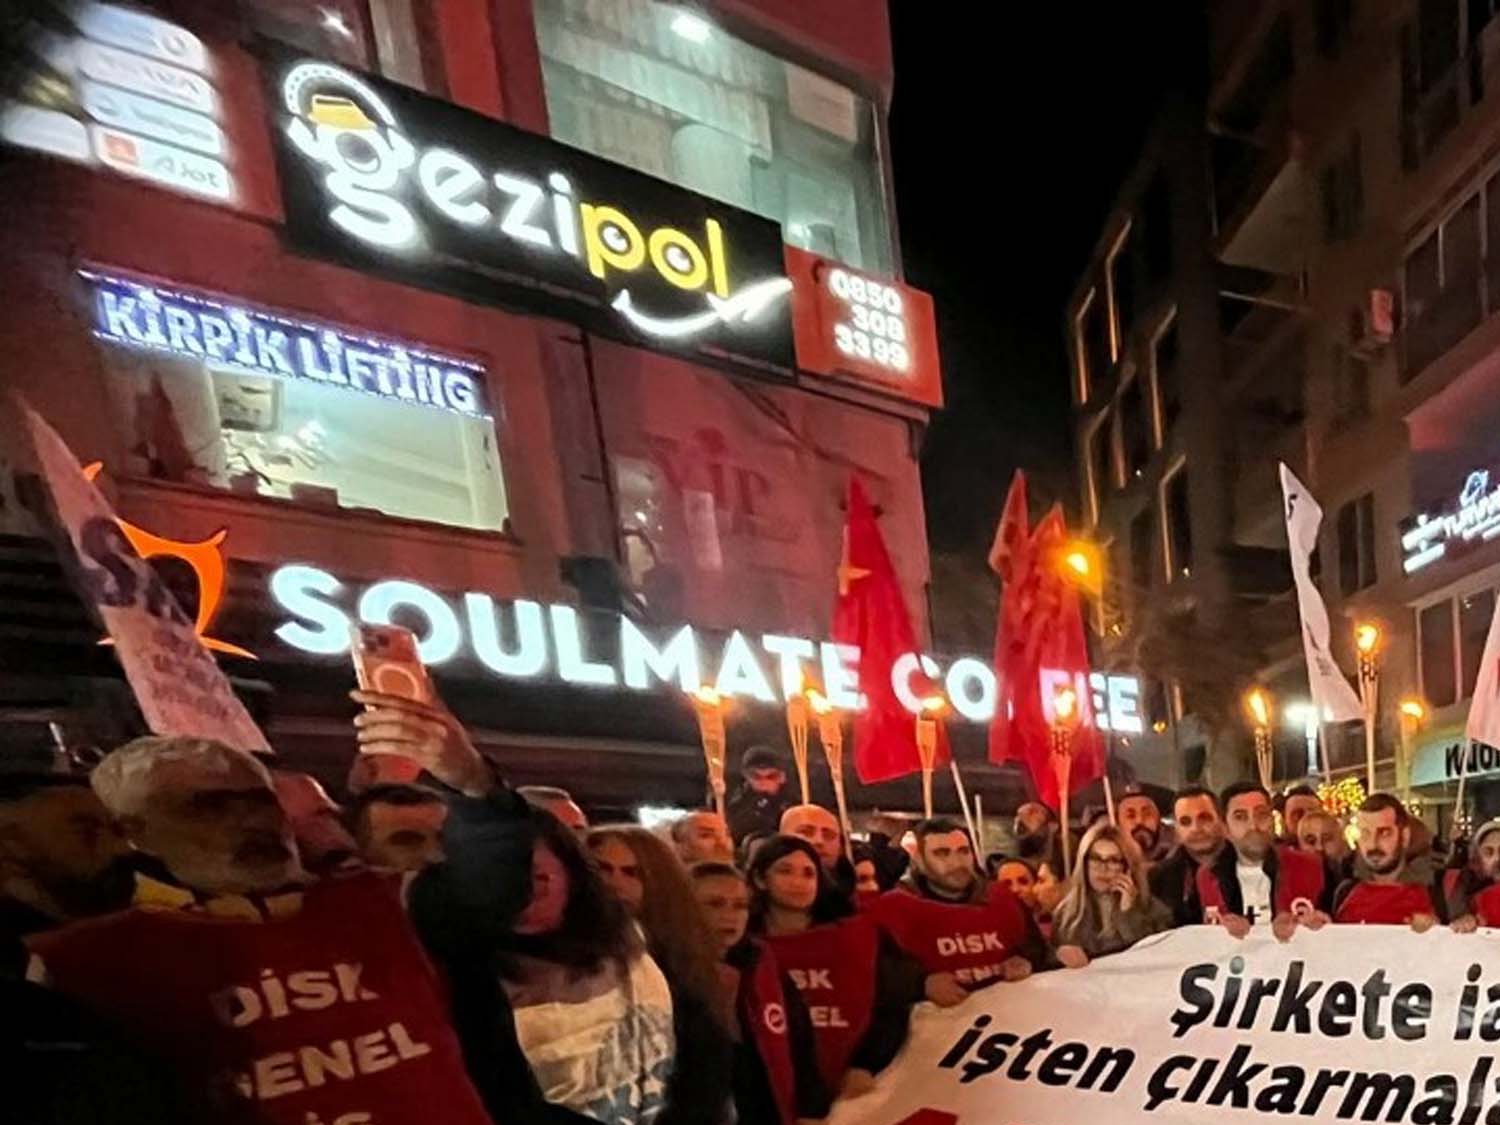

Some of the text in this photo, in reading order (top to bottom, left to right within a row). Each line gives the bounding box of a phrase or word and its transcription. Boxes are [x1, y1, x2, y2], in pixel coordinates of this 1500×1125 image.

[288, 98, 731, 298] gezipol
[828, 268, 902, 315] 0850
[270, 563, 868, 711] SOULMATE
[890, 651, 1143, 733] COFEE
[936, 932, 1004, 957] DİSK
[1170, 955, 1434, 1042] Şirkete
[234, 1022, 433, 1100] ENEL
[938, 1014, 1136, 1094] işten
